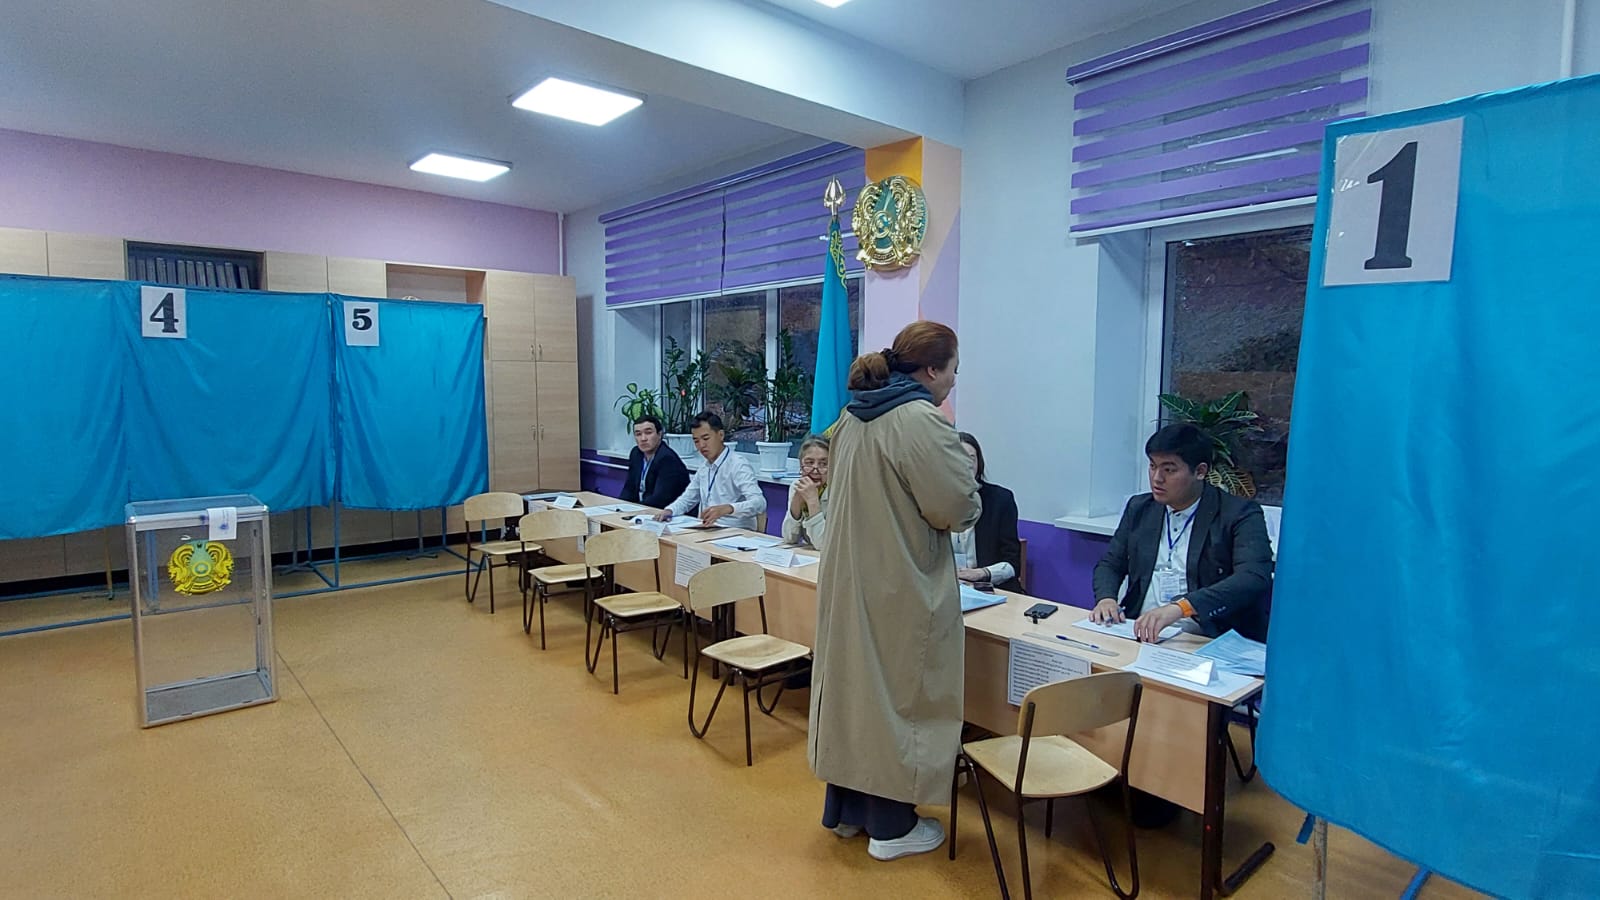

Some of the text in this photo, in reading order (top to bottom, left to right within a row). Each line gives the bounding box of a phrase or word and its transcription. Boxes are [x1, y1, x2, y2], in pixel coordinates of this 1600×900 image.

[1364, 141, 1418, 270] 1
[150, 292, 179, 333] 4
[352, 308, 373, 331] 5
